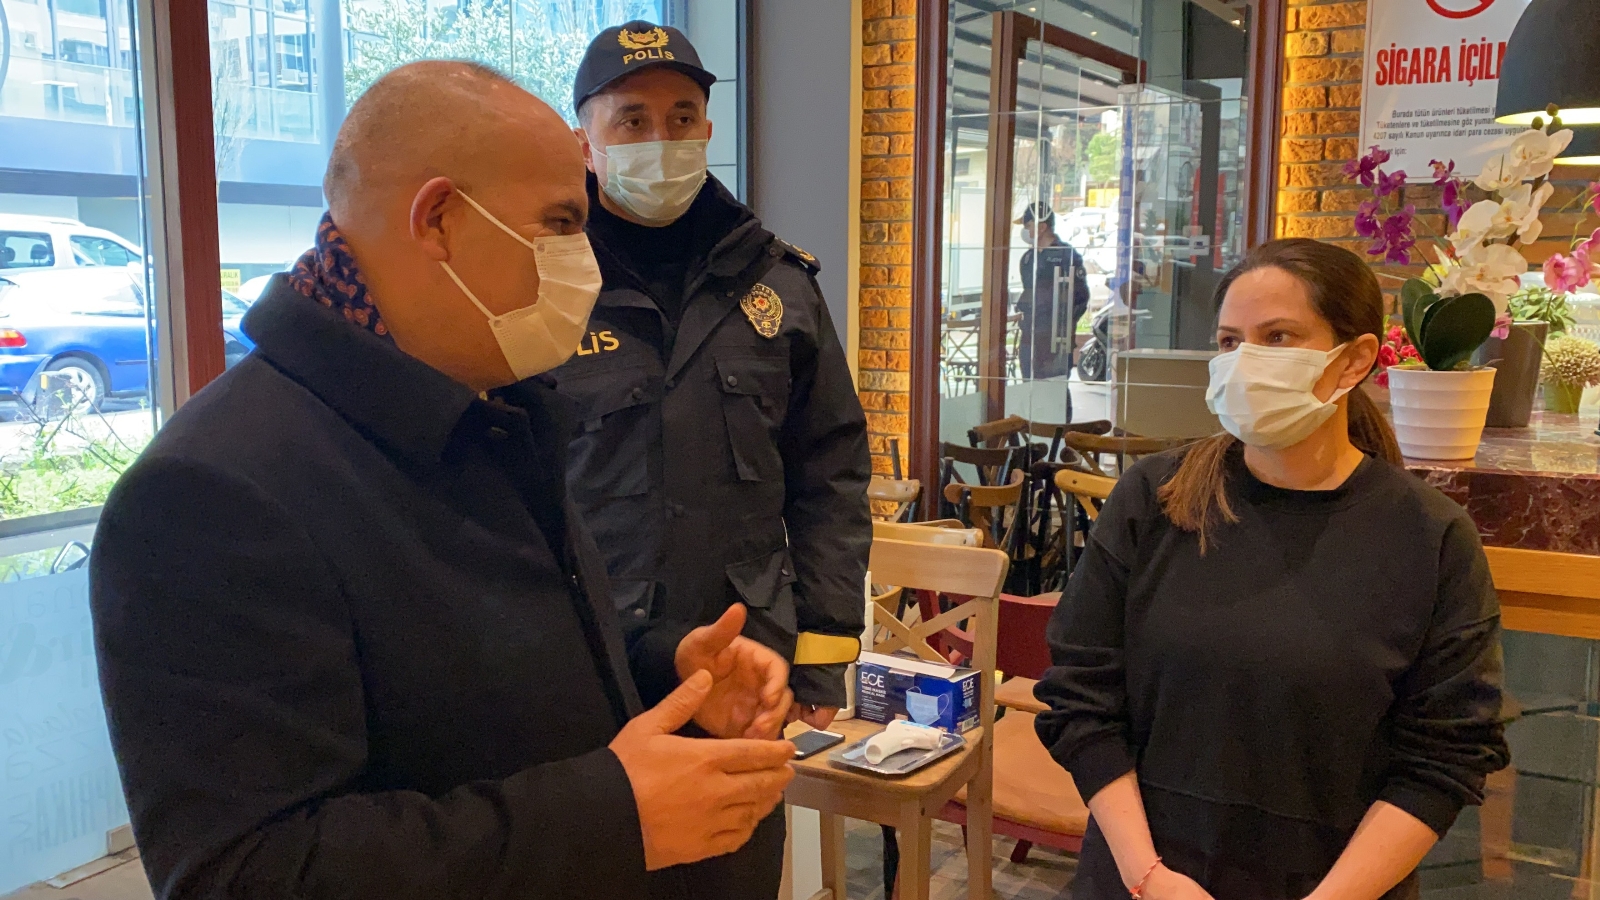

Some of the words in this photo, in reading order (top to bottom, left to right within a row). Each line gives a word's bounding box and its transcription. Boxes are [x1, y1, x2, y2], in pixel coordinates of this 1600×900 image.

[622, 47, 675, 65] POLİS
[1375, 42, 1451, 86] SİGARA
[1391, 109, 1413, 118] Burada
[1414, 108, 1430, 117] tütün
[1431, 107, 1455, 116] ürünleri
[1456, 105, 1491, 115] tüketilmesi
[1461, 116, 1473, 128] göz
[1373, 131, 1387, 140] 4207
[1405, 131, 1424, 139] Kanun
[1425, 130, 1451, 140] uyarınca
[1452, 128, 1467, 137] idari
[1468, 129, 1482, 137] para
[1483, 128, 1503, 136] cezası
